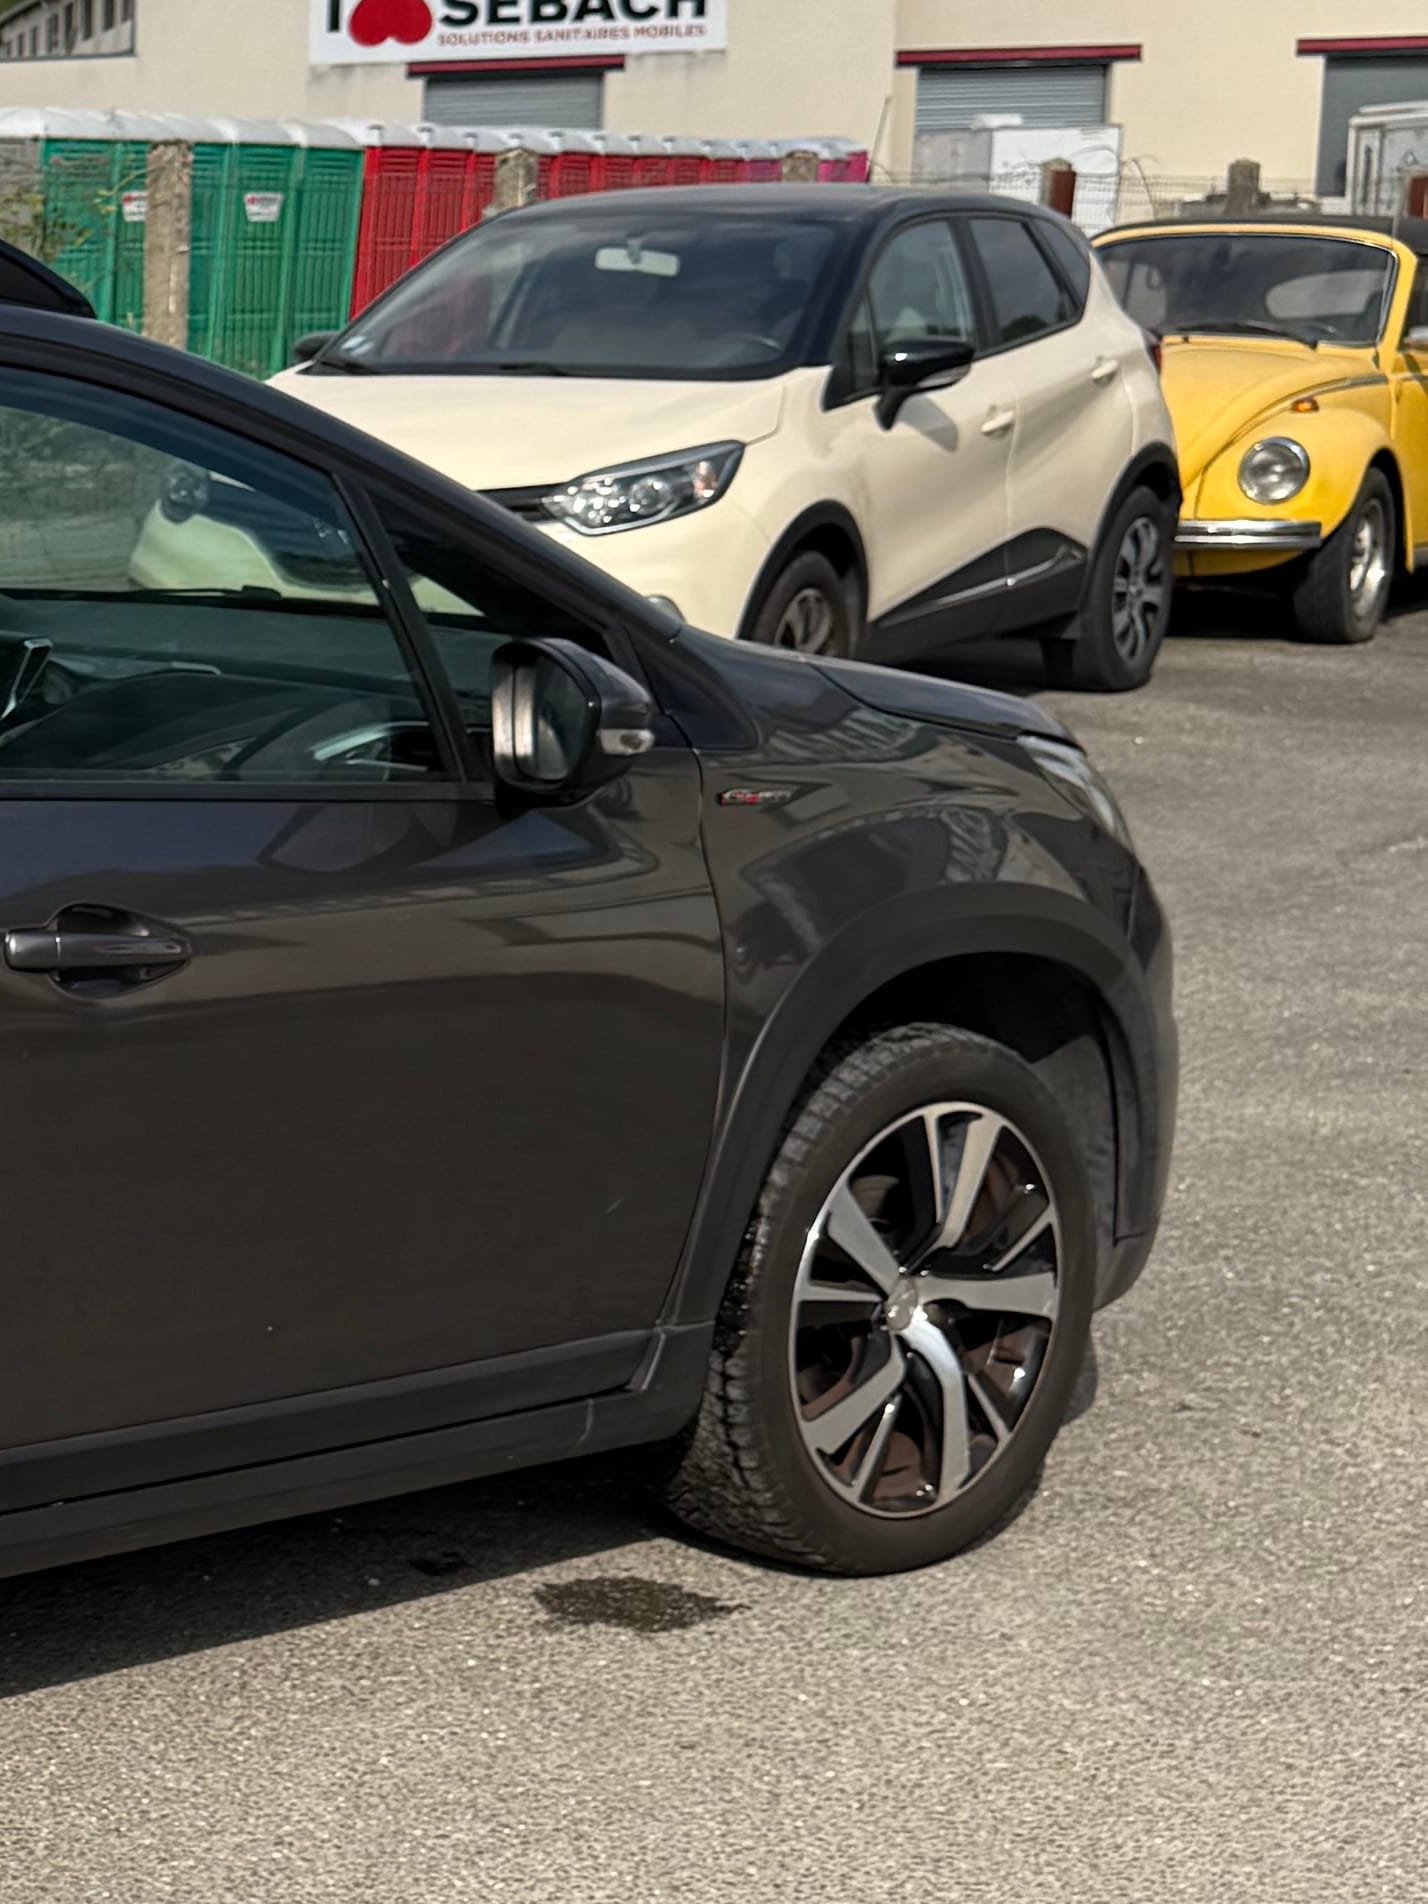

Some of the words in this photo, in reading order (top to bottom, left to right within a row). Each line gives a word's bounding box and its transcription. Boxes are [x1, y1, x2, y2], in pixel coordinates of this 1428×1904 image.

[437, 28, 529, 47] SOLUTIONS
[534, 25, 629, 44] SANITAIRES
[633, 23, 706, 40] MOBILES
